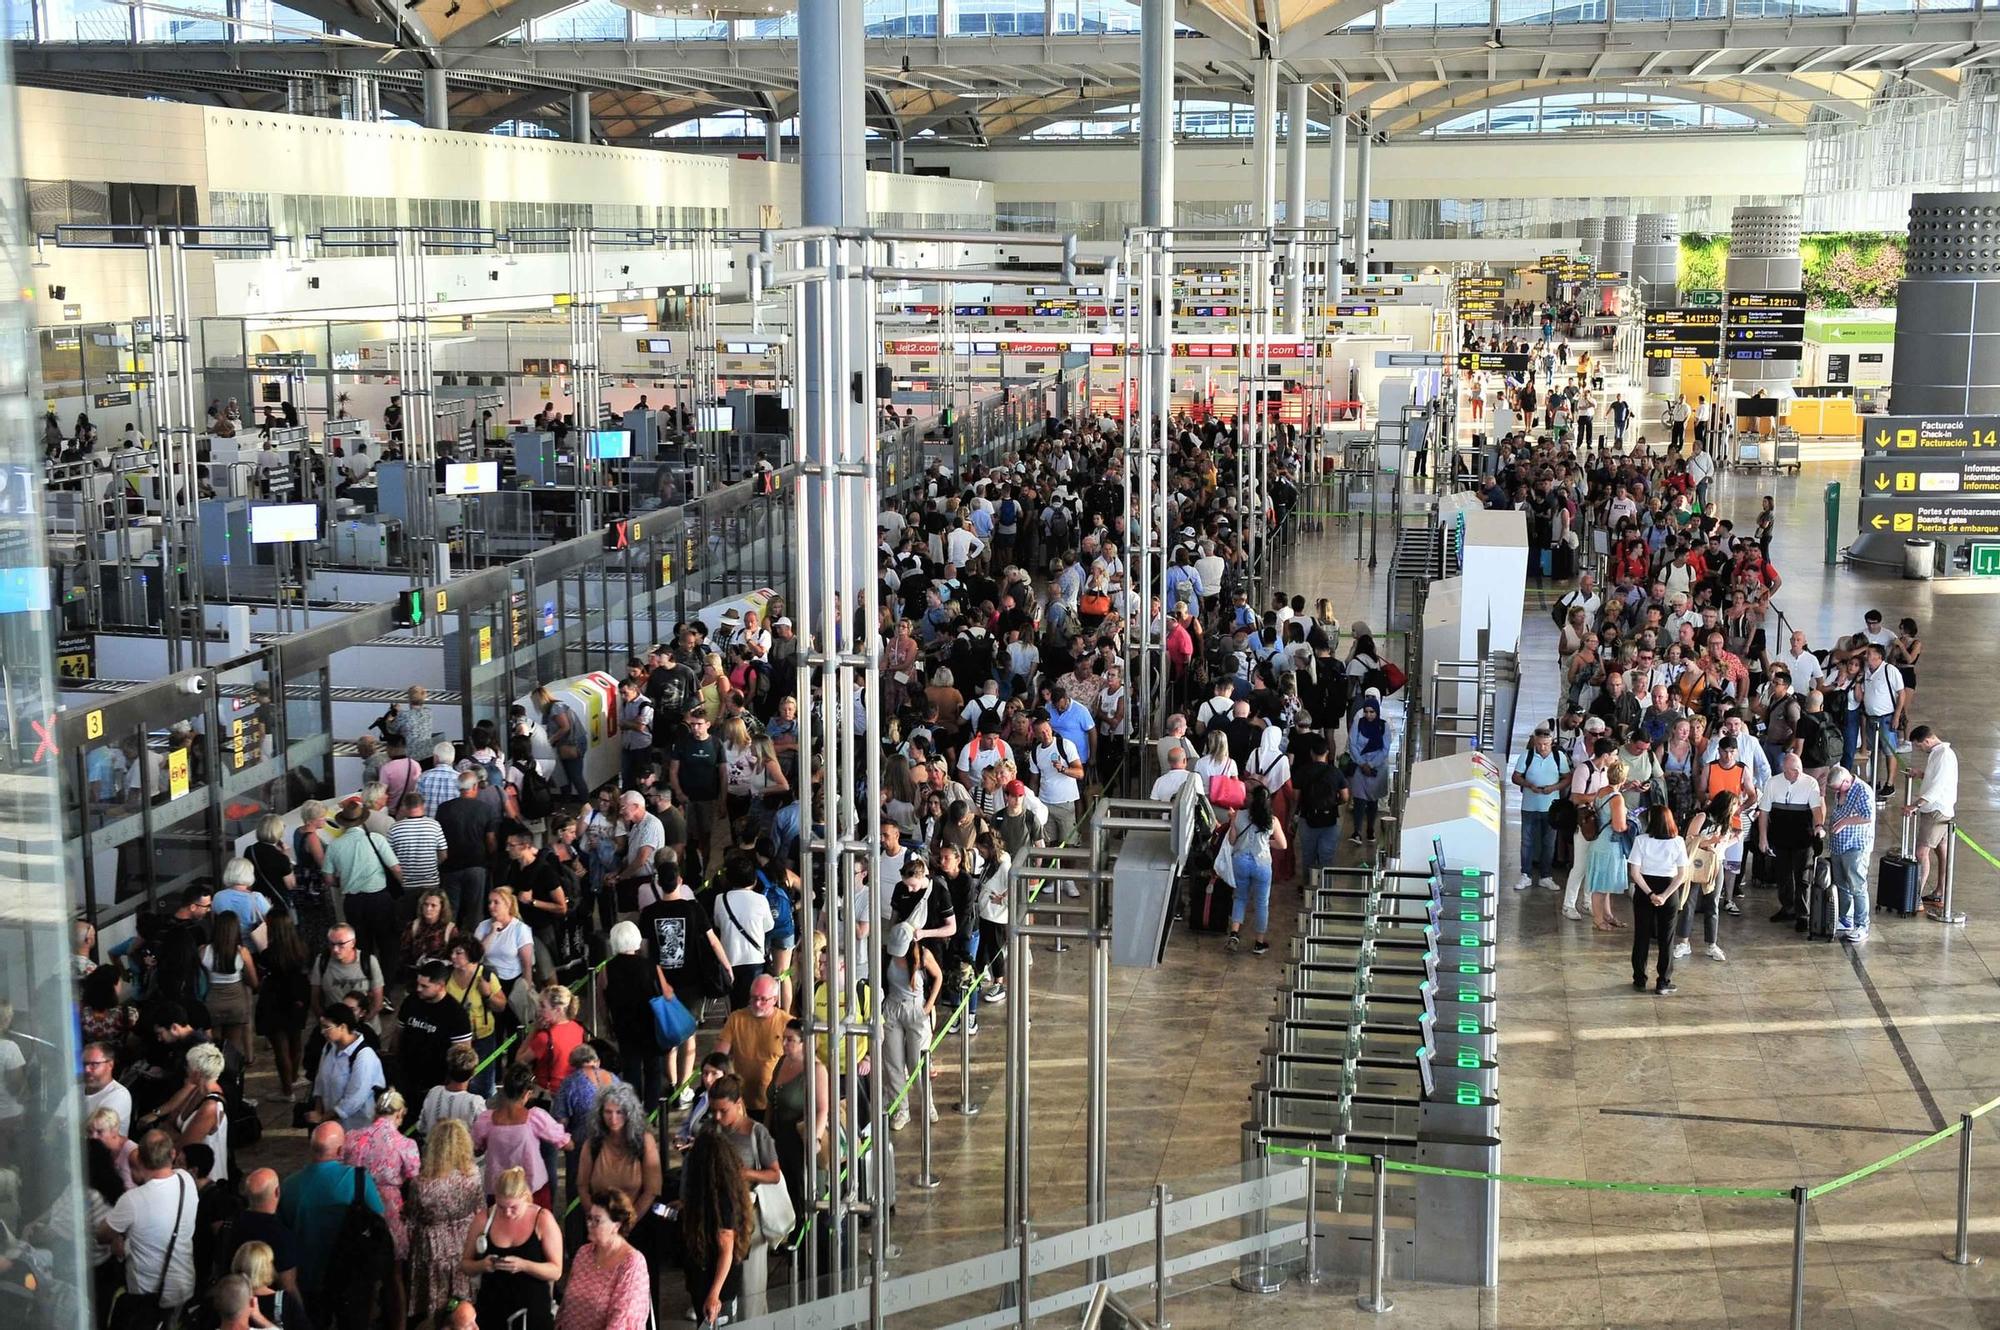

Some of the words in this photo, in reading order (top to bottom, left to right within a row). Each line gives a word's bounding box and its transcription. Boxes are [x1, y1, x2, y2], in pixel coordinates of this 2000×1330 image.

[896, 344, 940, 352] Jet2.com
[1921, 421, 1963, 430] Facturació
[1920, 438, 1968, 447] Facturación
[1972, 430, 2000, 447] 14
[1918, 516, 1947, 524] Boarding
[1960, 525, 1998, 533] embarque
[91, 715, 98, 734] 3
